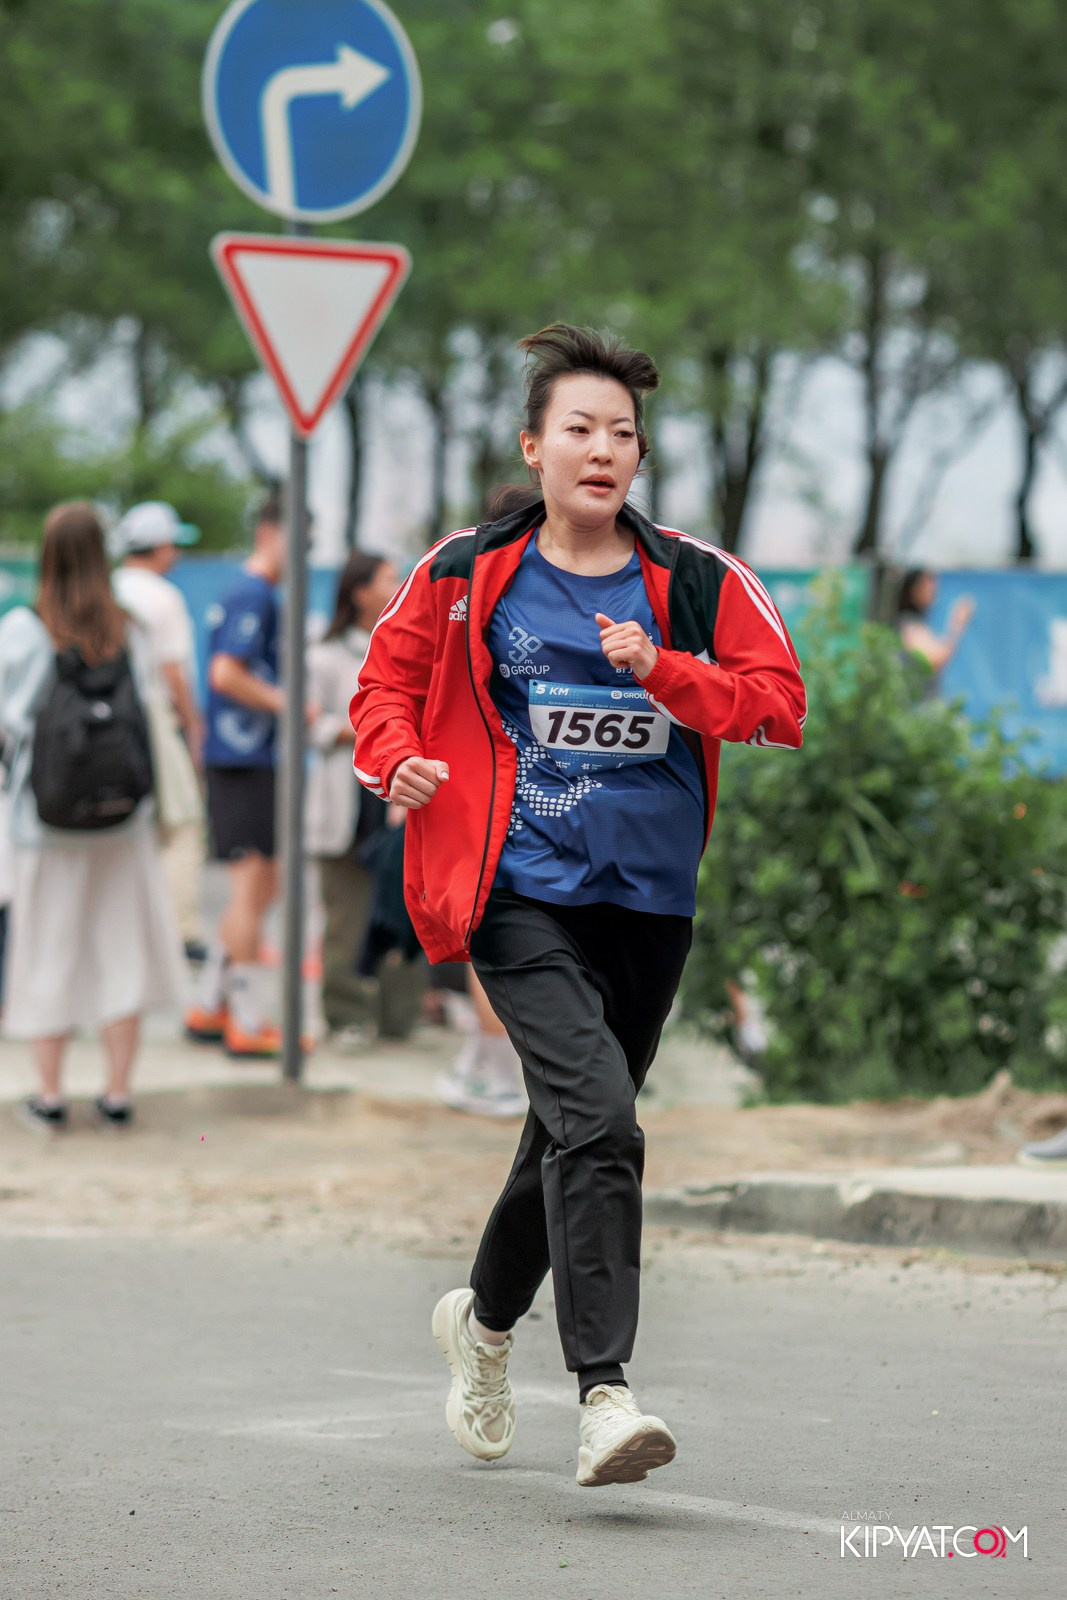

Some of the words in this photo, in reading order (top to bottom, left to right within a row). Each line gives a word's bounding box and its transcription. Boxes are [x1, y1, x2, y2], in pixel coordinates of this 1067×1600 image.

[511, 665, 551, 675] GROUP
[535, 684, 547, 695] 5
[549, 687, 570, 696] KM
[547, 710, 656, 750] 1565
